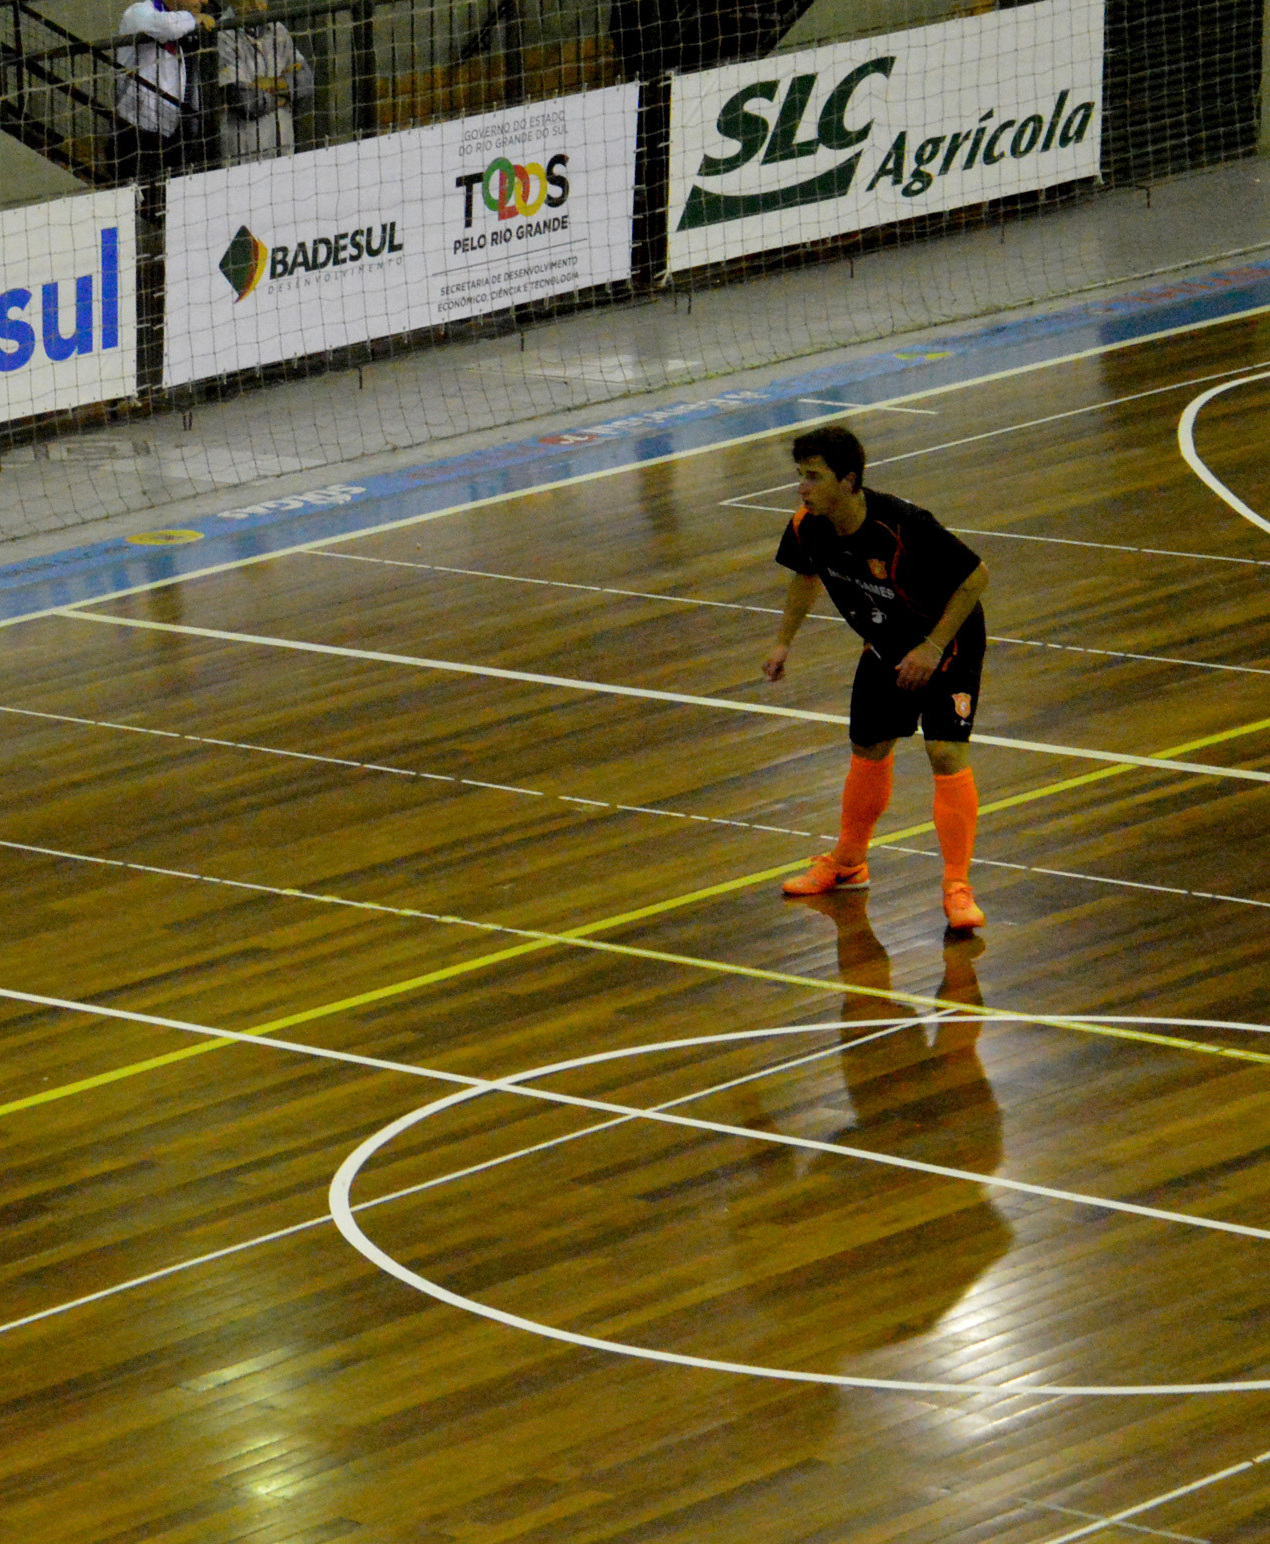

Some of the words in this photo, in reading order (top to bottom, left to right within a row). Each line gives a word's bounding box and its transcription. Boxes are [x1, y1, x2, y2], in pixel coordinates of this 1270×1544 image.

[464, 122, 510, 142] GOVERNO
[513, 118, 527, 133] DO
[530, 110, 565, 128] ESTADO
[698, 56, 897, 177] SLC
[458, 145, 473, 157] DO
[475, 140, 493, 153] RIO
[495, 131, 533, 149] GRANDE
[536, 127, 550, 140] DO
[552, 123, 569, 137] SUL
[866, 90, 1096, 198] Agrícola
[455, 153, 570, 229] TODOS
[269, 221, 404, 280] BADESUL
[453, 233, 487, 255] PELO
[490, 228, 513, 247] RIO
[516, 214, 570, 240] GRANDE
[267, 257, 403, 295] DESENVOLVIMENTO
[440, 278, 490, 297] SECRETARIA
[491, 274, 503, 286] DE
[503, 256, 579, 282] DESENVOLVIMENTO
[490, 285, 522, 301] CIÊNCIA
[530, 271, 580, 291] TECNOLOGIA
